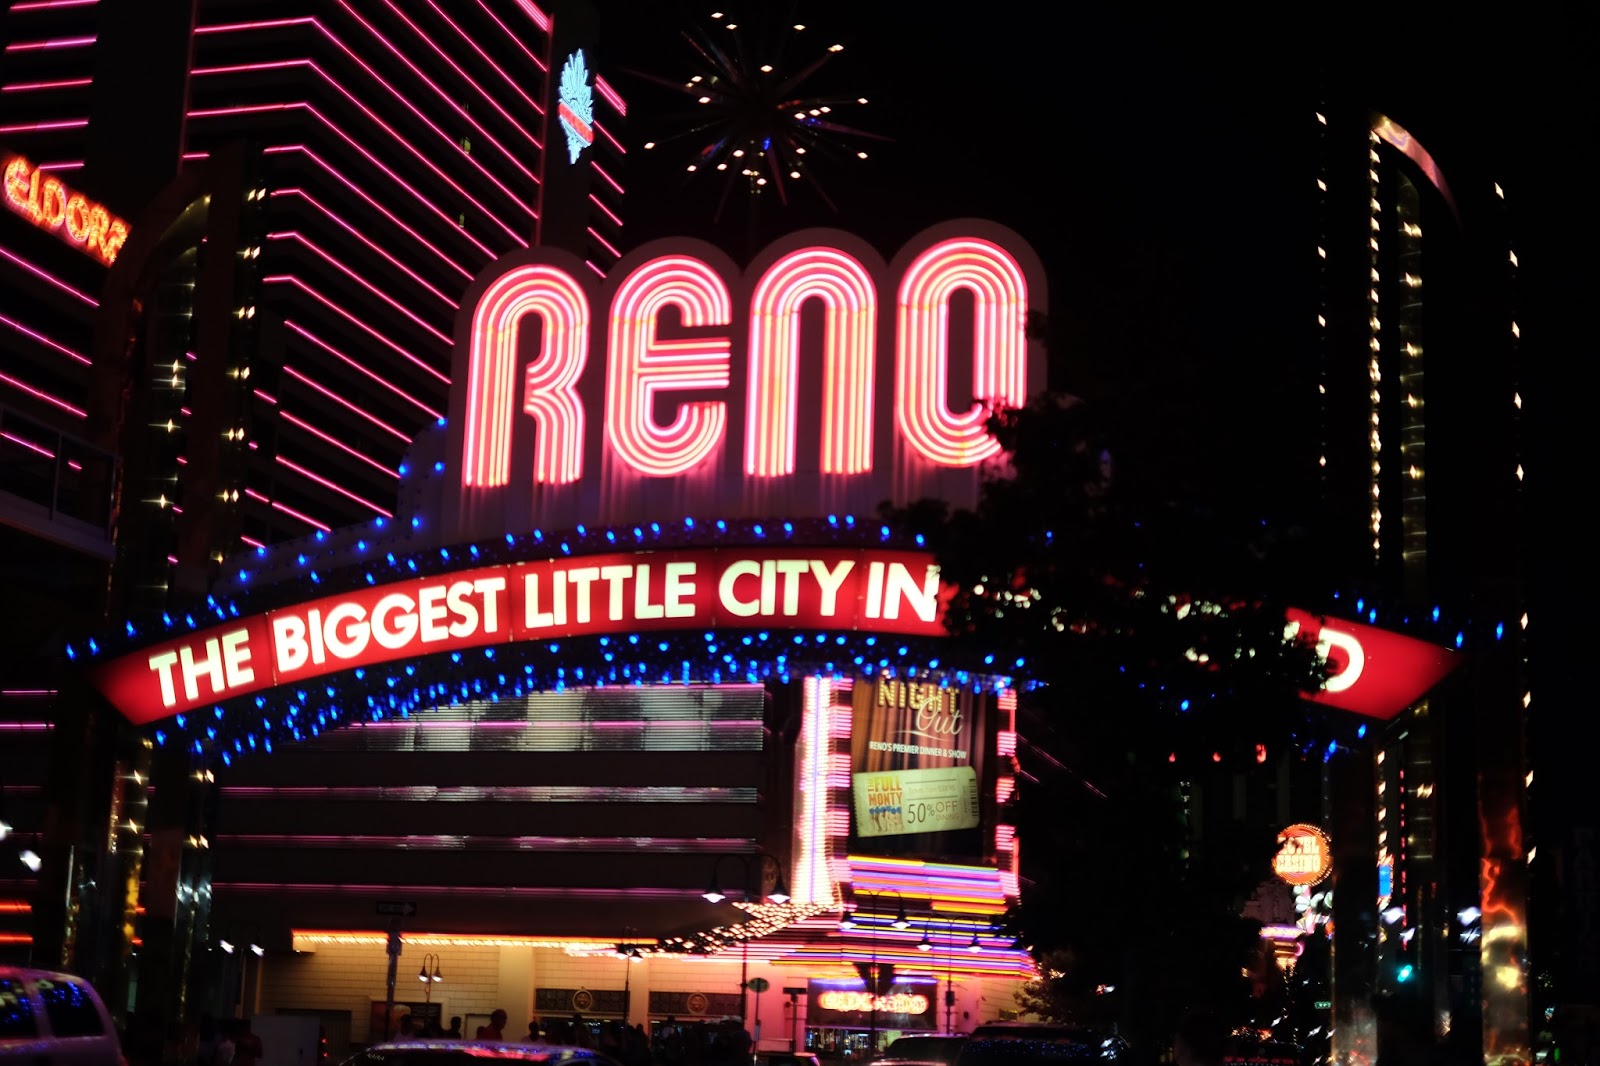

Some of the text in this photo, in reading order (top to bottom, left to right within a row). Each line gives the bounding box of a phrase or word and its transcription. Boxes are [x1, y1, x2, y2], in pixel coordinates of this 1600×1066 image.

[461, 236, 1028, 488] RENO
[148, 559, 941, 709] THE BIGGEST LITTLE CITY IN
[879, 679, 960, 714] NIGHT
[916, 696, 964, 735] Out
[869, 741, 892, 752] RENO'S
[893, 743, 919, 755] PREMIER
[919, 746, 943, 757] DINNER
[948, 750, 967, 760] SHOW
[874, 776, 903, 792] FULL
[868, 792, 903, 806] MONTY
[936, 800, 958, 812] OFF
[1276, 855, 1321, 872] CASINO
